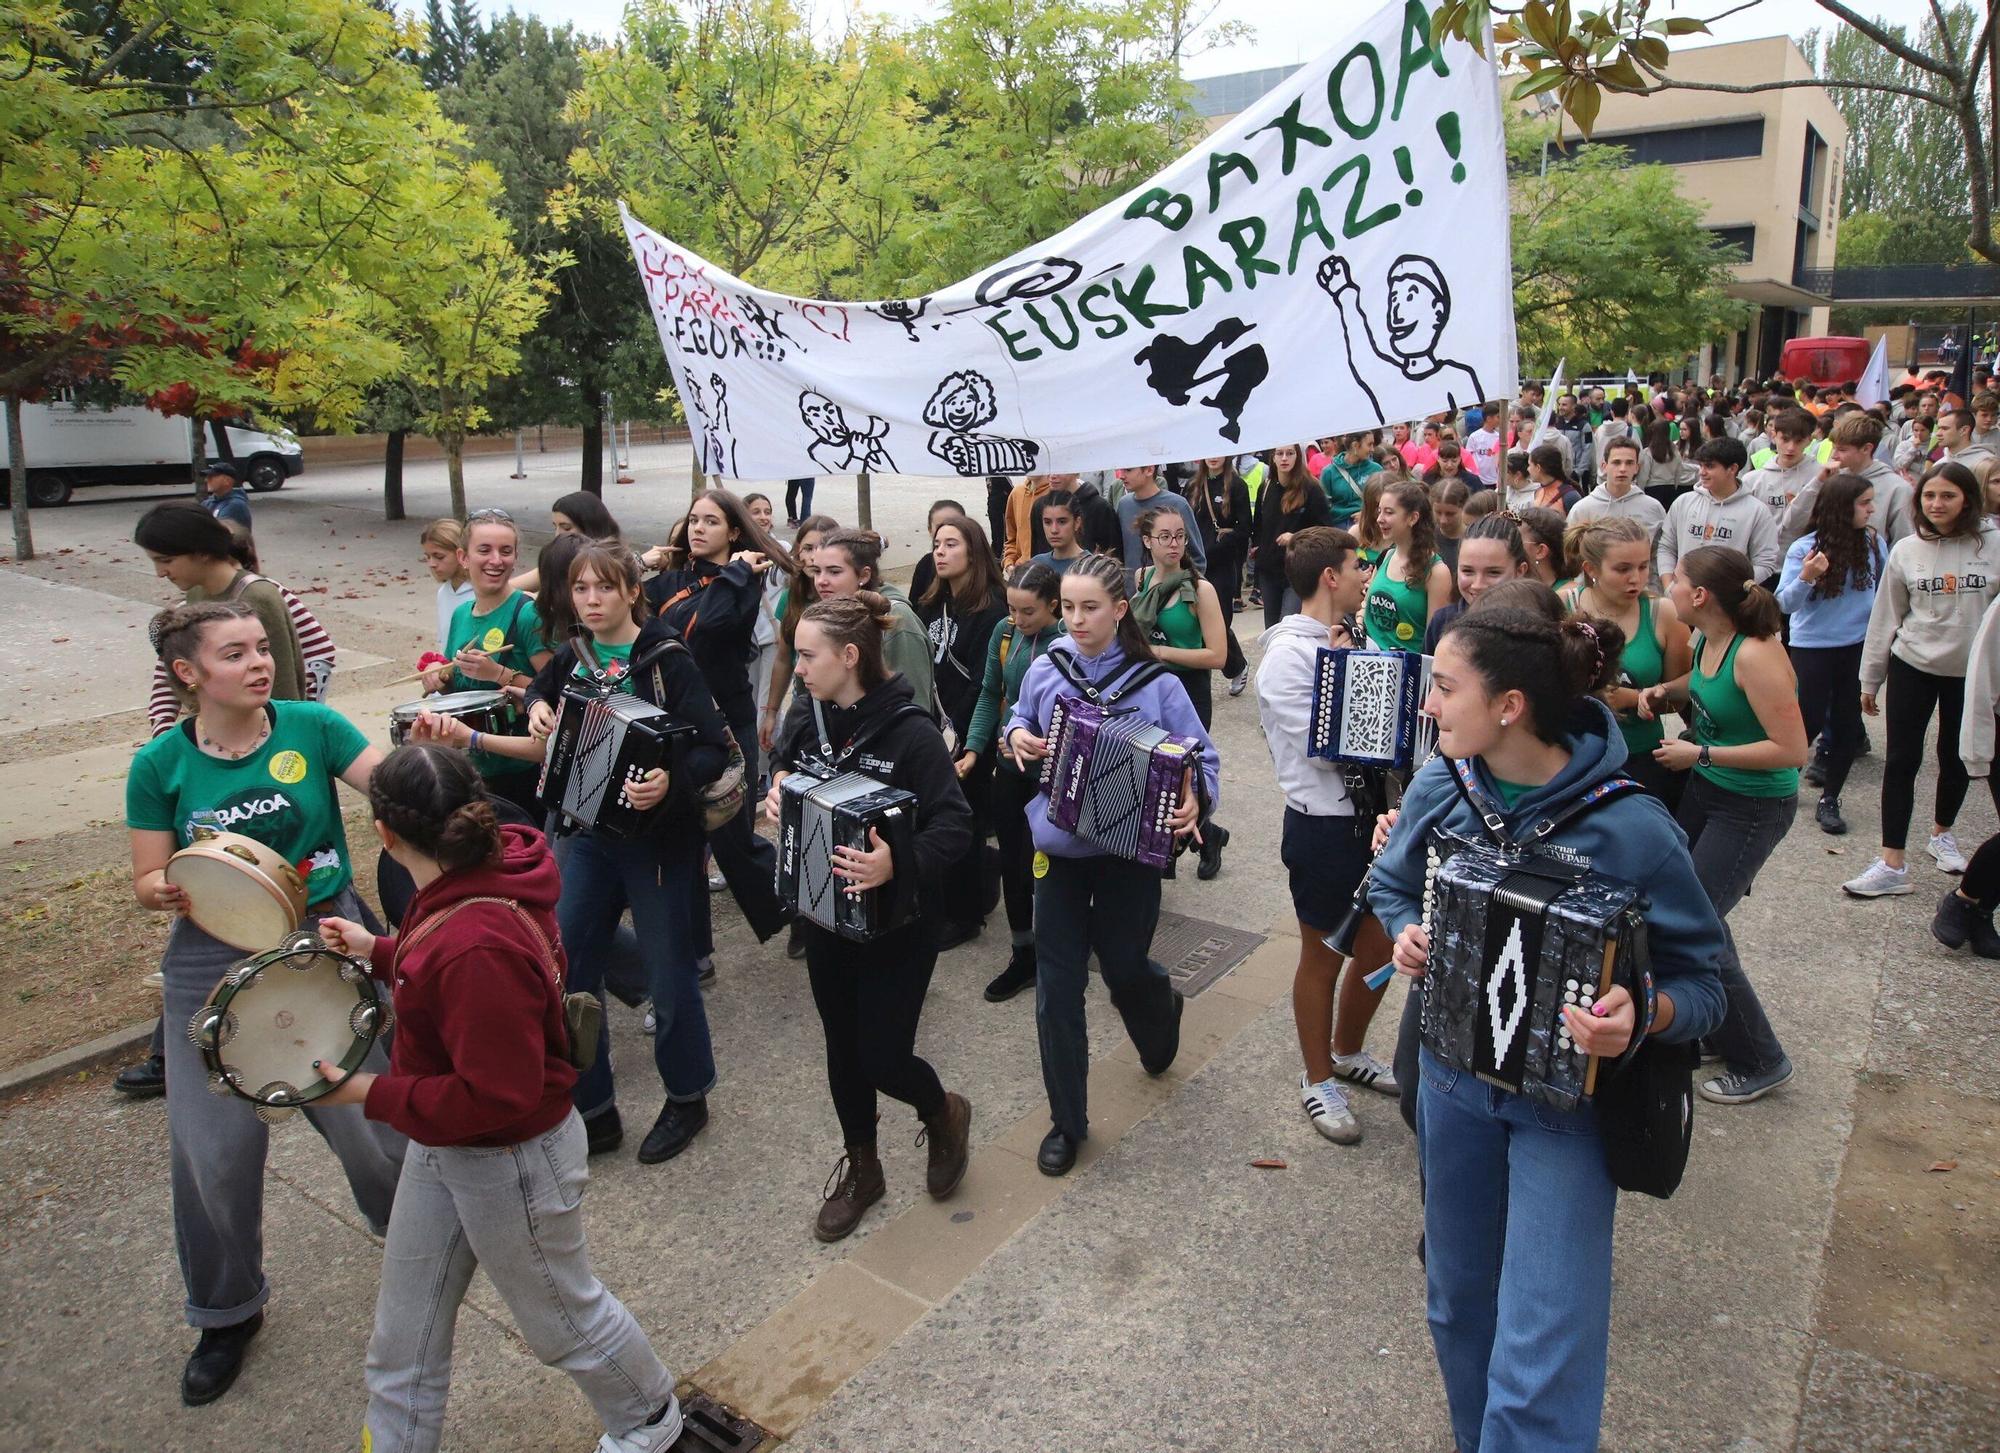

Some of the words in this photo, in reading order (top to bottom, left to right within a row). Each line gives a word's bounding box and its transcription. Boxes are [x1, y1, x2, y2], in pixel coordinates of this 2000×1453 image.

[1123, 0, 1450, 232] BAXOA
[985, 111, 1467, 362] EUSKARAZ!!
[1371, 595, 1397, 612] BAXOA
[214, 793, 291, 826] BAXOA
